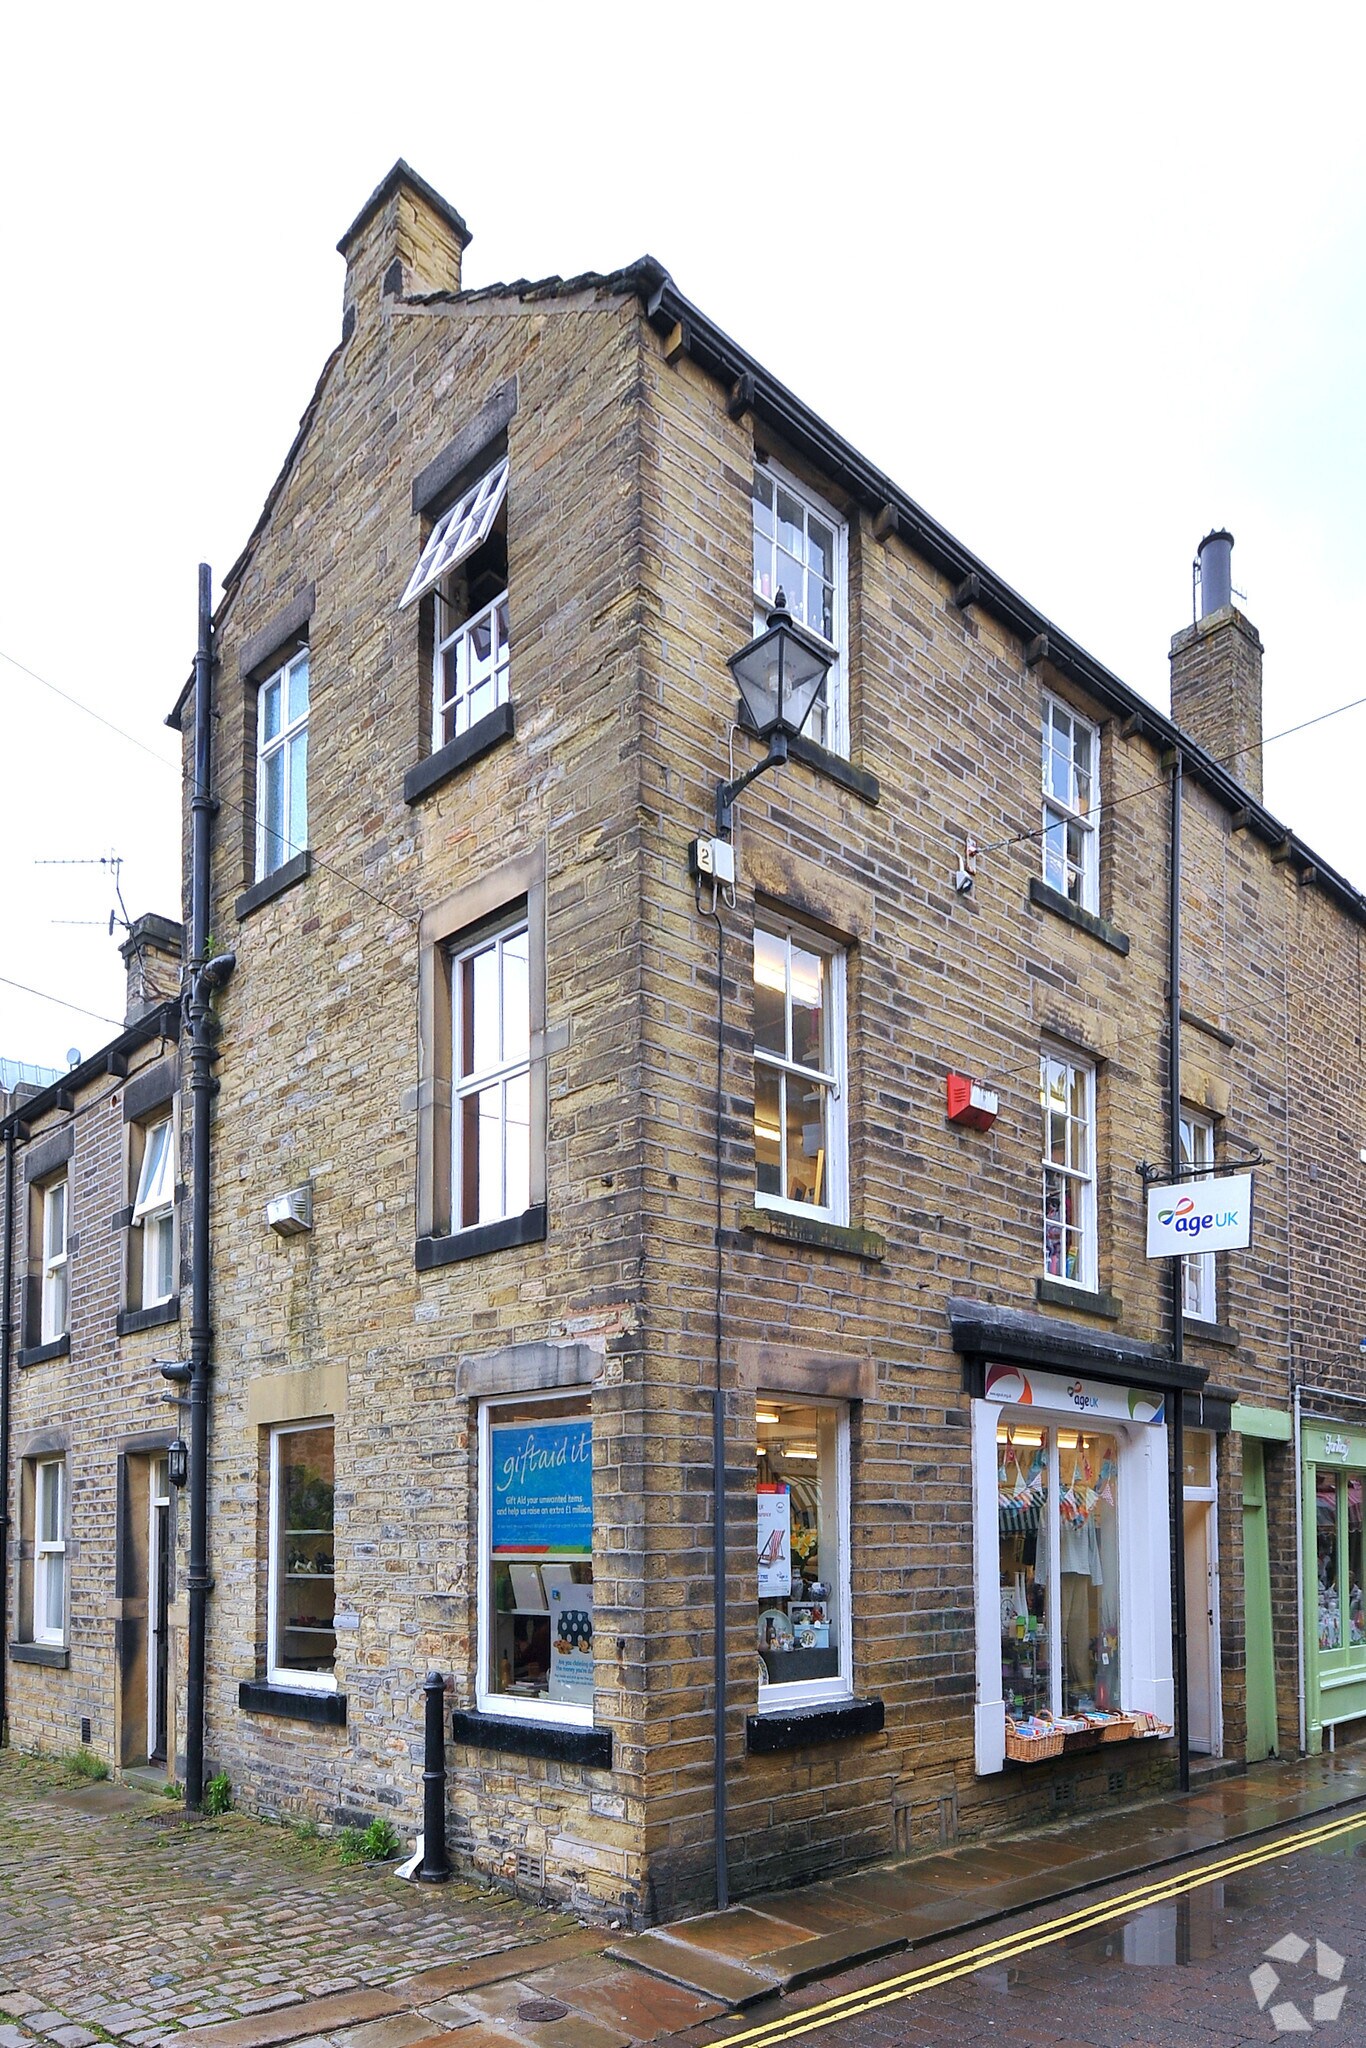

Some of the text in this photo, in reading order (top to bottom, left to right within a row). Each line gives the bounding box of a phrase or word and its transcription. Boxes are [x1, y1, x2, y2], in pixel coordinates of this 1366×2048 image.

[701, 847, 709, 865] 2
[505, 1494, 583, 1506] Gift Aid your unwanted items
[496, 1507, 507, 1516] and
[507, 1506, 519, 1517] help
[527, 1506, 540, 1515] raise
[549, 1506, 565, 1514] extra
